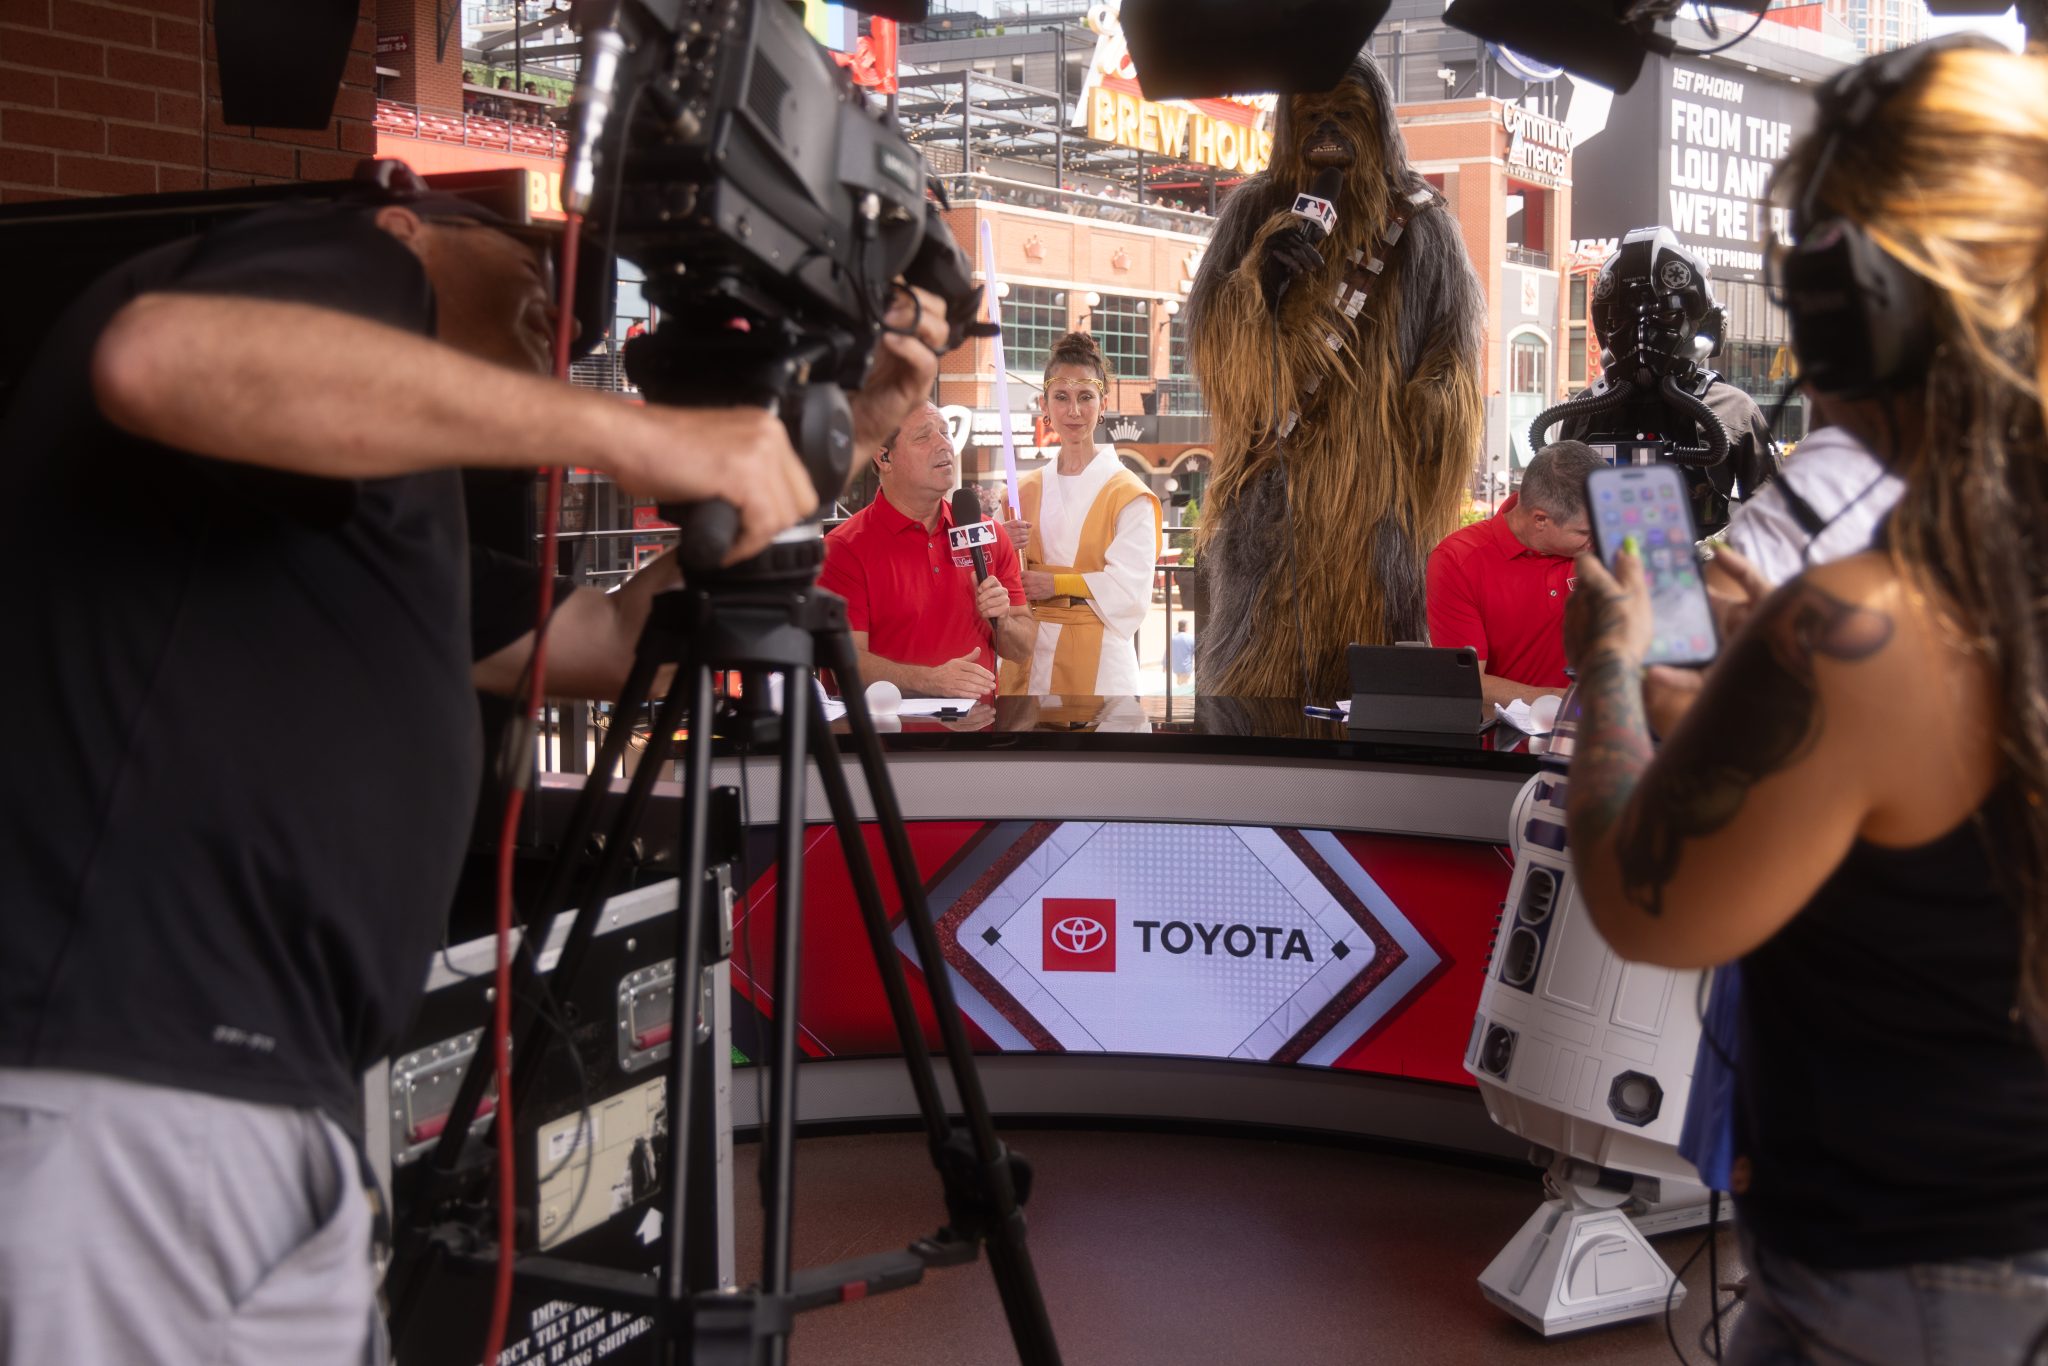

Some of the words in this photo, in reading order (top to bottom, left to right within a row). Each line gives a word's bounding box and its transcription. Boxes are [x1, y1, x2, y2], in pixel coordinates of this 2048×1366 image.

[1673, 67, 1694, 92] 1ST
[1693, 74, 1744, 103] PHORM
[1089, 87, 1190, 158] BREW
[1189, 113, 1273, 175] HOUS
[1503, 100, 1574, 157] Community
[1671, 98, 1741, 153] FROM
[1745, 115, 1792, 160] THE
[1670, 144, 1719, 192] LOU
[1723, 156, 1774, 200] AND
[1669, 190, 1748, 241] WE'RE
[1133, 920, 1314, 962] TOYOTA
[536, 1316, 569, 1348] TILT
[571, 1316, 606, 1351] ITEM
